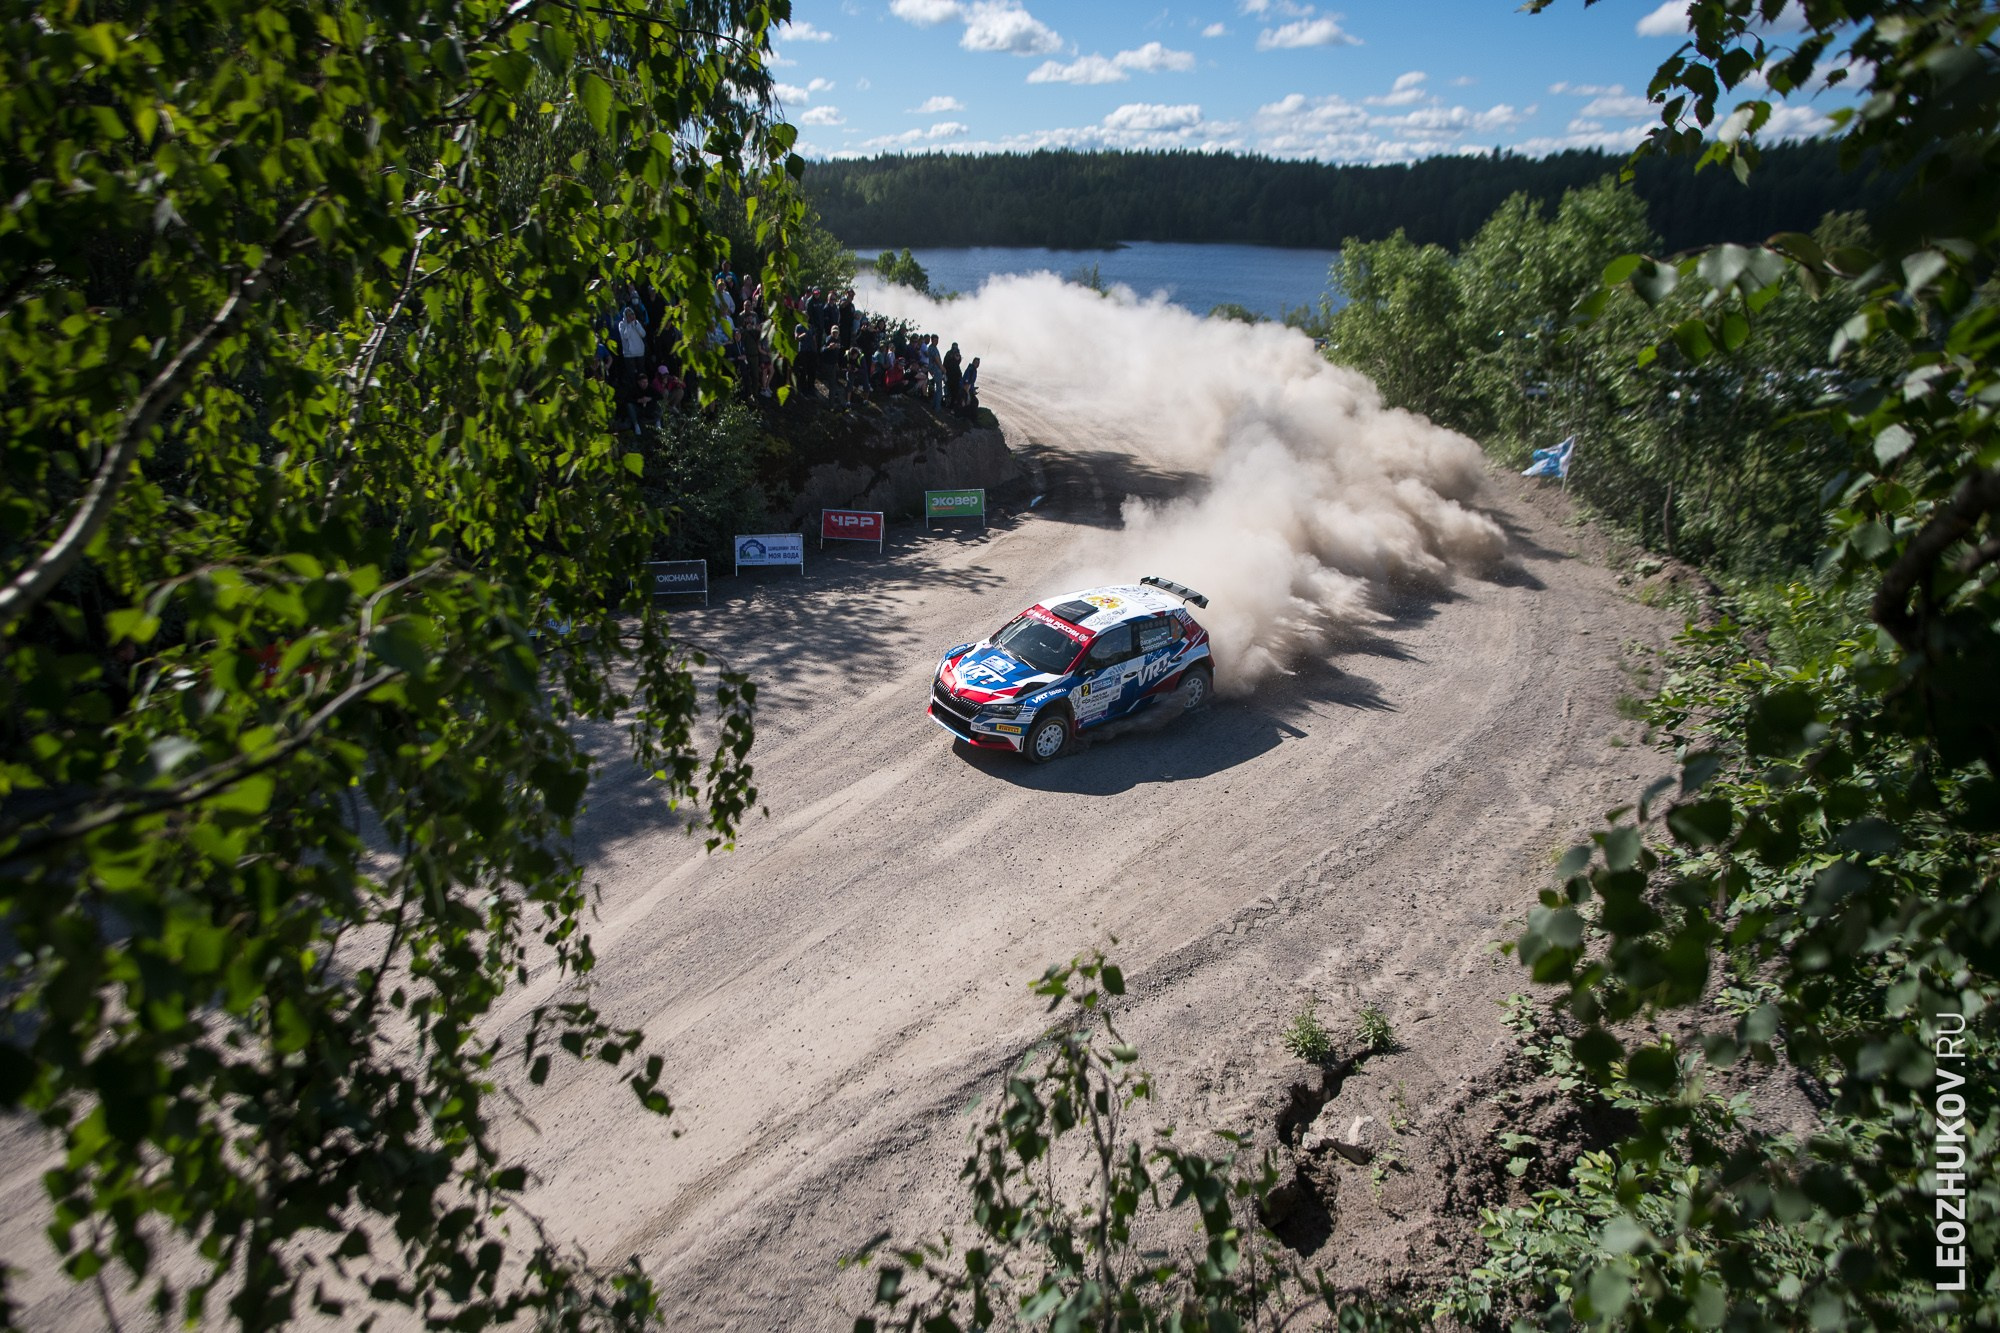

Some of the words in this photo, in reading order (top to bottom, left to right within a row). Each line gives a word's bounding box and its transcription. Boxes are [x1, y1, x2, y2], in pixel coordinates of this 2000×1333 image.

[1054, 620, 1080, 637] РОССИИ
[1083, 684, 1089, 697] 2
[1031, 691, 1049, 704] VRT
